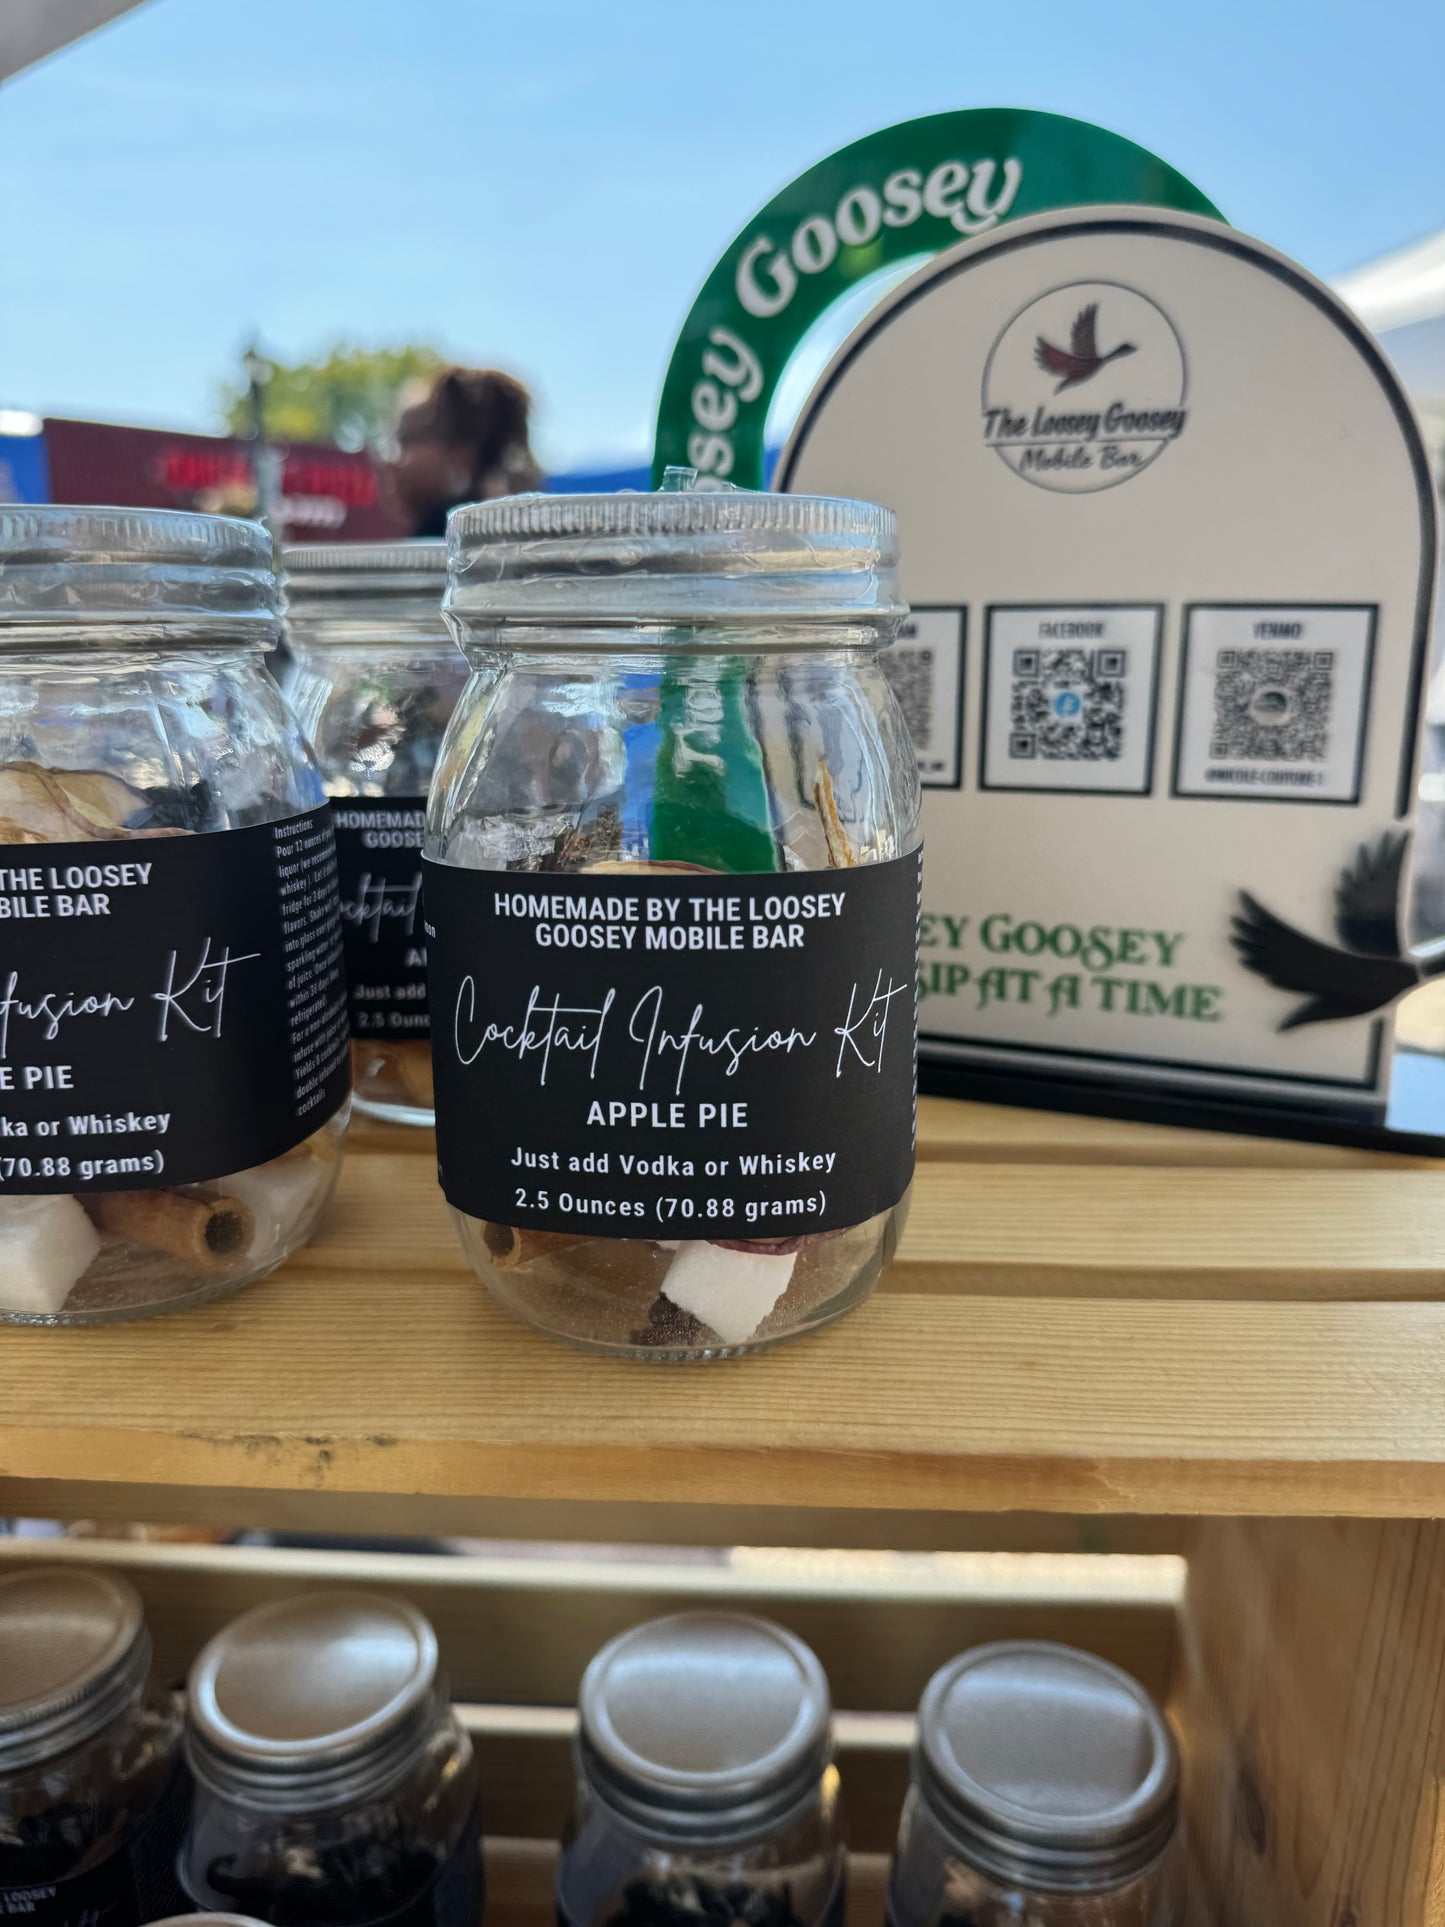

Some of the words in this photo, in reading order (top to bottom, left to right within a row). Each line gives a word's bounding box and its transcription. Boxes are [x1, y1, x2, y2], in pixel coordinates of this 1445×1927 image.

[735, 156, 1023, 319] Goosey
[983, 408, 1028, 439] The
[1031, 405, 1101, 443] Loosey
[1102, 401, 1188, 441] Goosey
[1020, 446, 1093, 472] Mobile
[1098, 445, 1143, 470] Bar
[49, 863, 152, 890] LOOSEY
[56, 894, 111, 917] BAR
[495, 891, 639, 922] HOMEMADE
[647, 897, 680, 922] BY
[689, 896, 741, 922] THE
[749, 891, 846, 921] LOOSEY
[536, 923, 637, 950] GOOSEY
[645, 925, 745, 950] MOBILE
[752, 924, 805, 949] BAR
[152, 936, 261, 1042] Kit
[1091, 975, 1223, 1023] TIME
[455, 975, 615, 1086] Cocktail
[628, 985, 817, 1096] Infusion
[834, 968, 908, 1079] Kit
[24, 1065, 74, 1090] PIE
[36, 1121, 61, 1137] or
[68, 1111, 171, 1136] Whiskey
[586, 1101, 686, 1128] APPLE
[699, 1102, 748, 1128] PIE
[77, 1149, 164, 1180] grams)
[510, 1147, 560, 1169] Just
[568, 1152, 609, 1174] add
[619, 1155, 694, 1176] Vodka
[704, 1160, 729, 1176] or
[738, 1151, 837, 1177] Whiskey
[515, 1188, 549, 1210] 2.5
[558, 1192, 645, 1217] Ounces
[656, 1196, 735, 1222] (70.88
[745, 1190, 826, 1222] grams)
